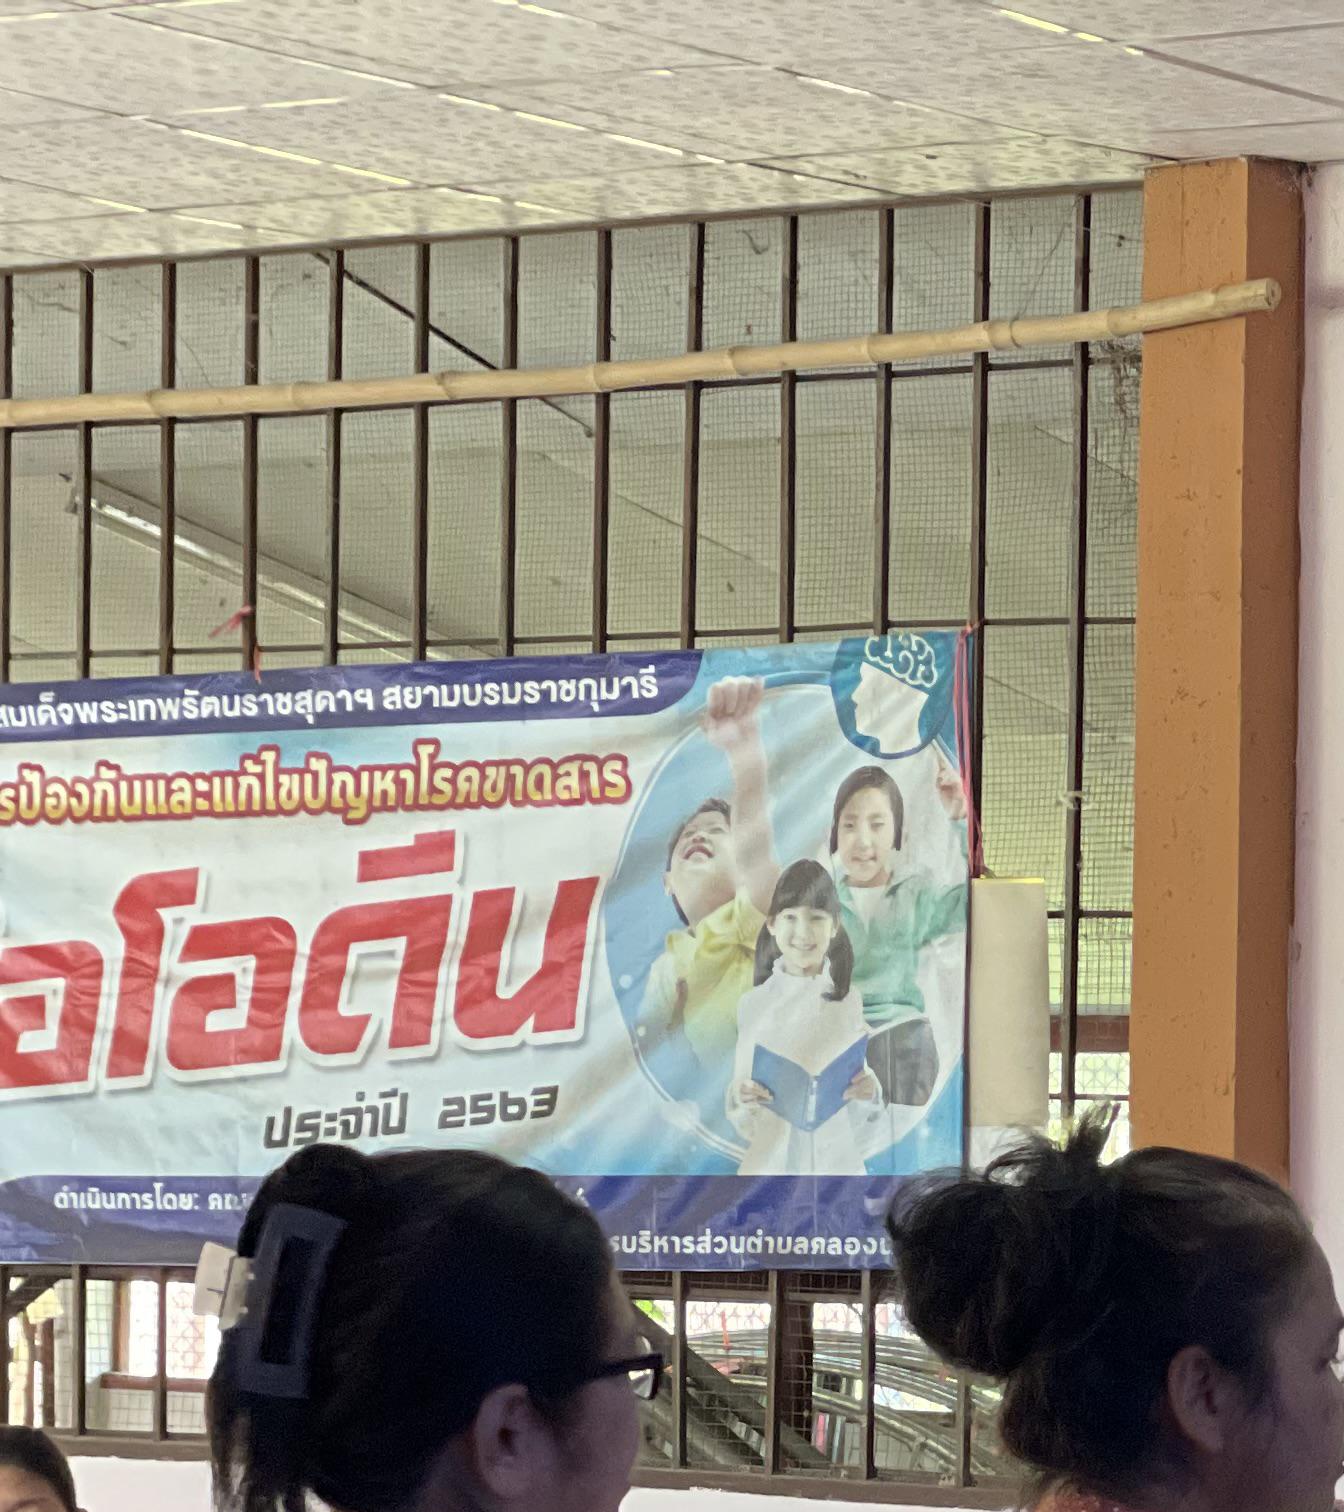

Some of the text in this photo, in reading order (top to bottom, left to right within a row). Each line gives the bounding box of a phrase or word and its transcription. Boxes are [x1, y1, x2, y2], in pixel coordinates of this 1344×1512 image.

[382, 664, 659, 712] สยามบรมราชกุมารี
[263, 1085, 559, 1149] ประจำปี 2563
